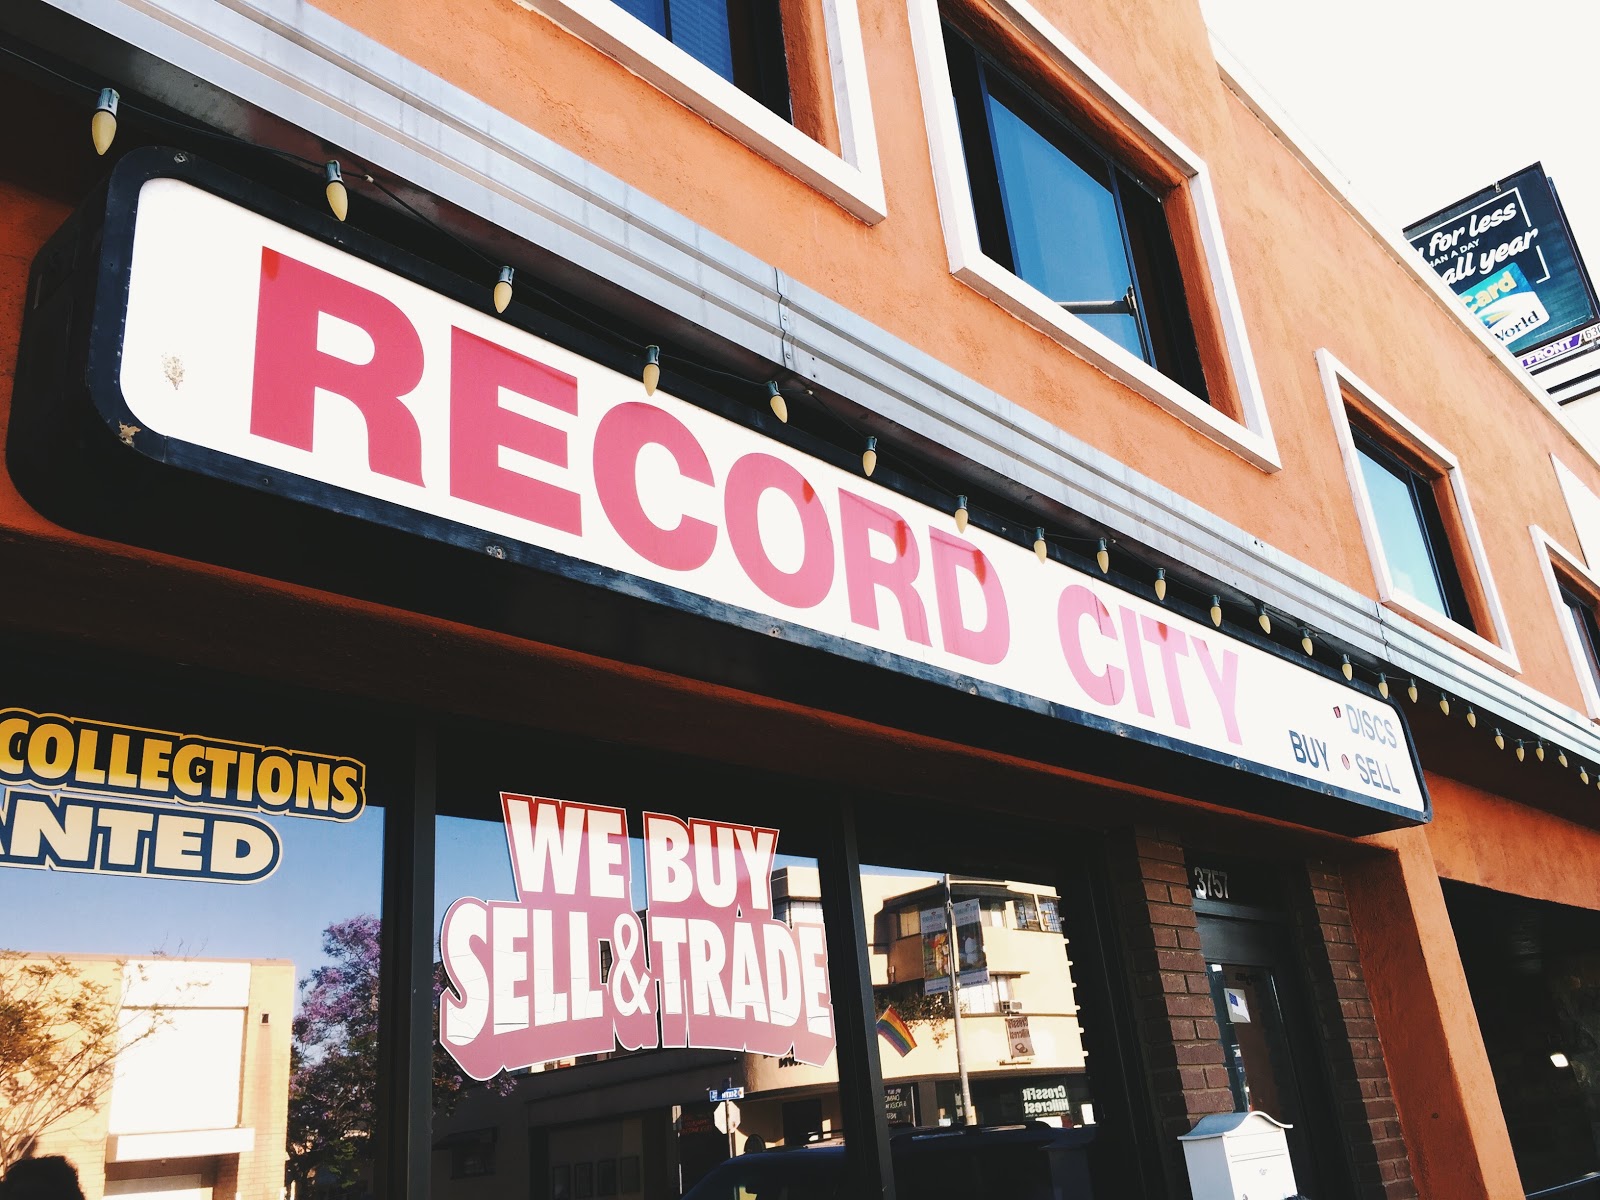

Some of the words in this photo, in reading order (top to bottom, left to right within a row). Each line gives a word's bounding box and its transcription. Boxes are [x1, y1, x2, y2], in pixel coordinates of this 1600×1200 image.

[1429, 226, 1465, 257] for
[1469, 202, 1517, 237] less
[1441, 252, 1477, 285] all
[1479, 228, 1539, 275] year
[1450, 250, 1459, 259] A
[1459, 238, 1480, 254] DAY
[1464, 270, 1518, 310] Card
[1526, 337, 1573, 365] FRONT
[250, 245, 1010, 666] RECORD
[1058, 585, 1242, 745] CITY
[1345, 703, 1397, 749] DISCS
[0, 717, 358, 814] COLLECTIONS
[1288, 729, 1330, 772] BUY
[1355, 753, 1401, 794] SELL
[0, 799, 275, 876] NTED
[506, 798, 626, 899] WE
[648, 817, 777, 911] BUY
[1194, 867, 1230, 899] 3757
[446, 902, 604, 1046] SELL
[612, 913, 651, 1017] &
[652, 916, 832, 1038] TRADE
